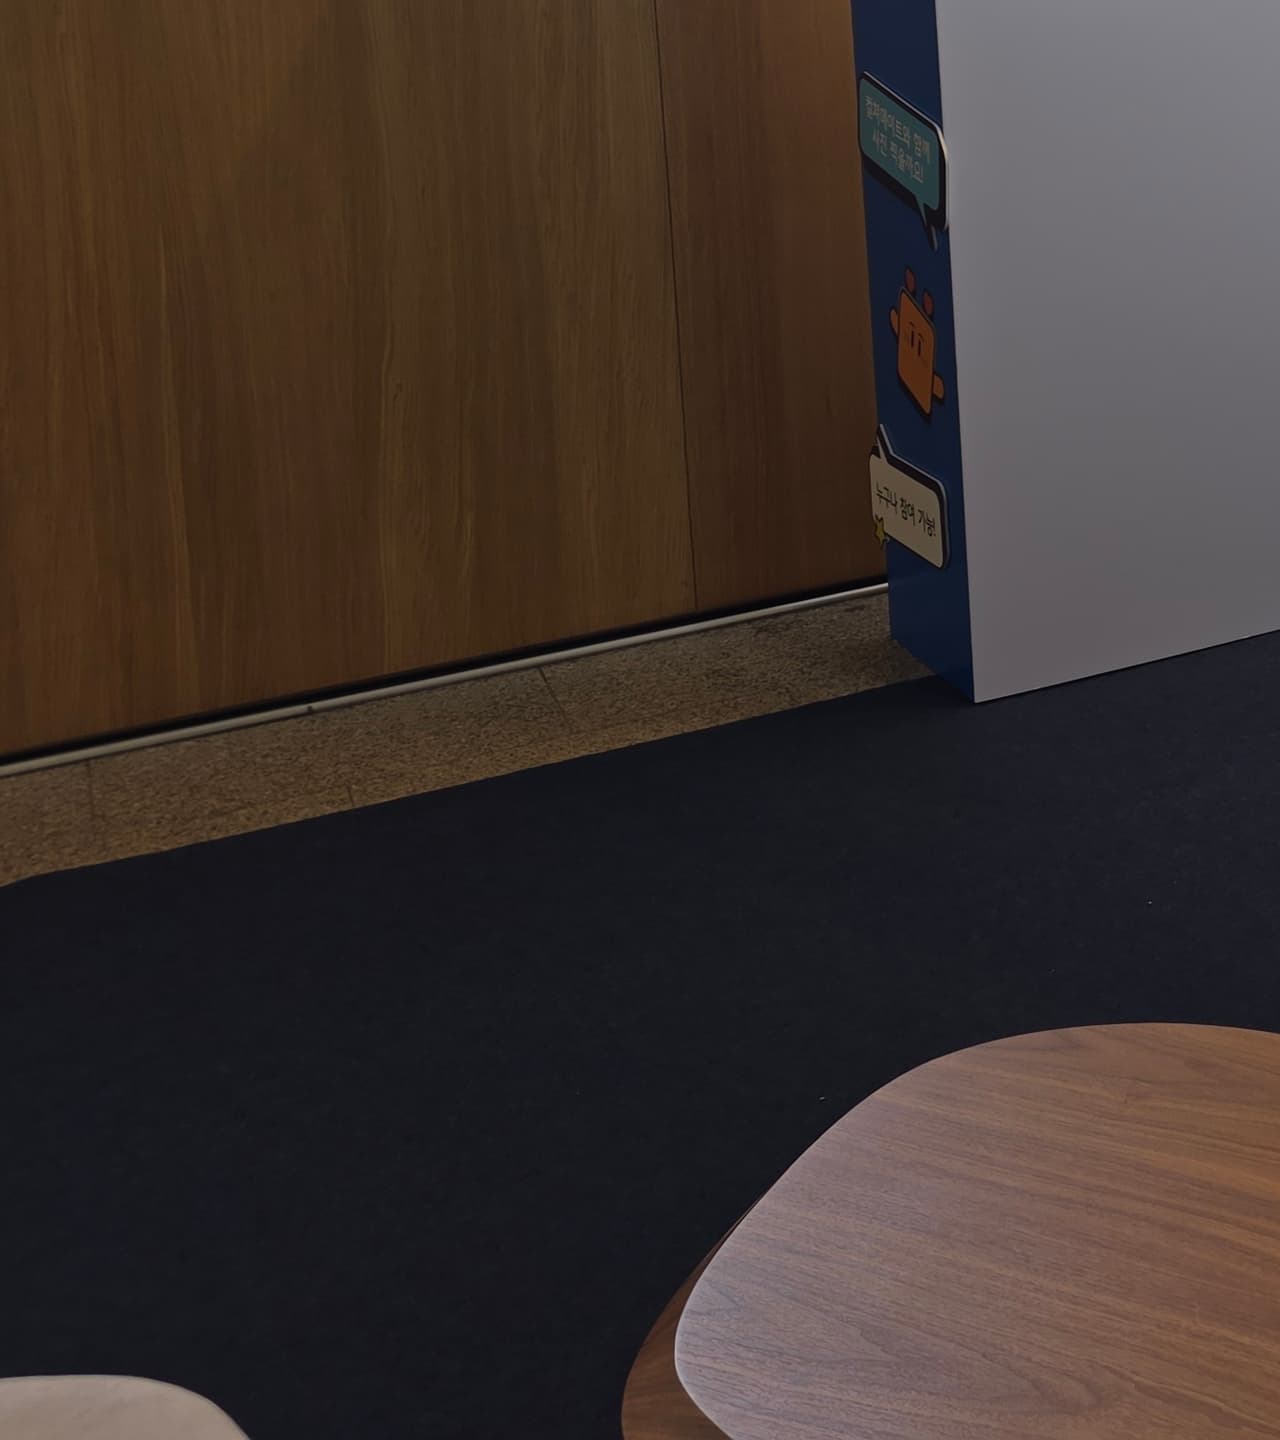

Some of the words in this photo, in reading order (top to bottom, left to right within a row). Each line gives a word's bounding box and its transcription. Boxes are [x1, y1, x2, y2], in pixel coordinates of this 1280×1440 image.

[875, 480, 898, 516] 누구나
[900, 496, 916, 528] 참여
[917, 507, 937, 538] 가능!
